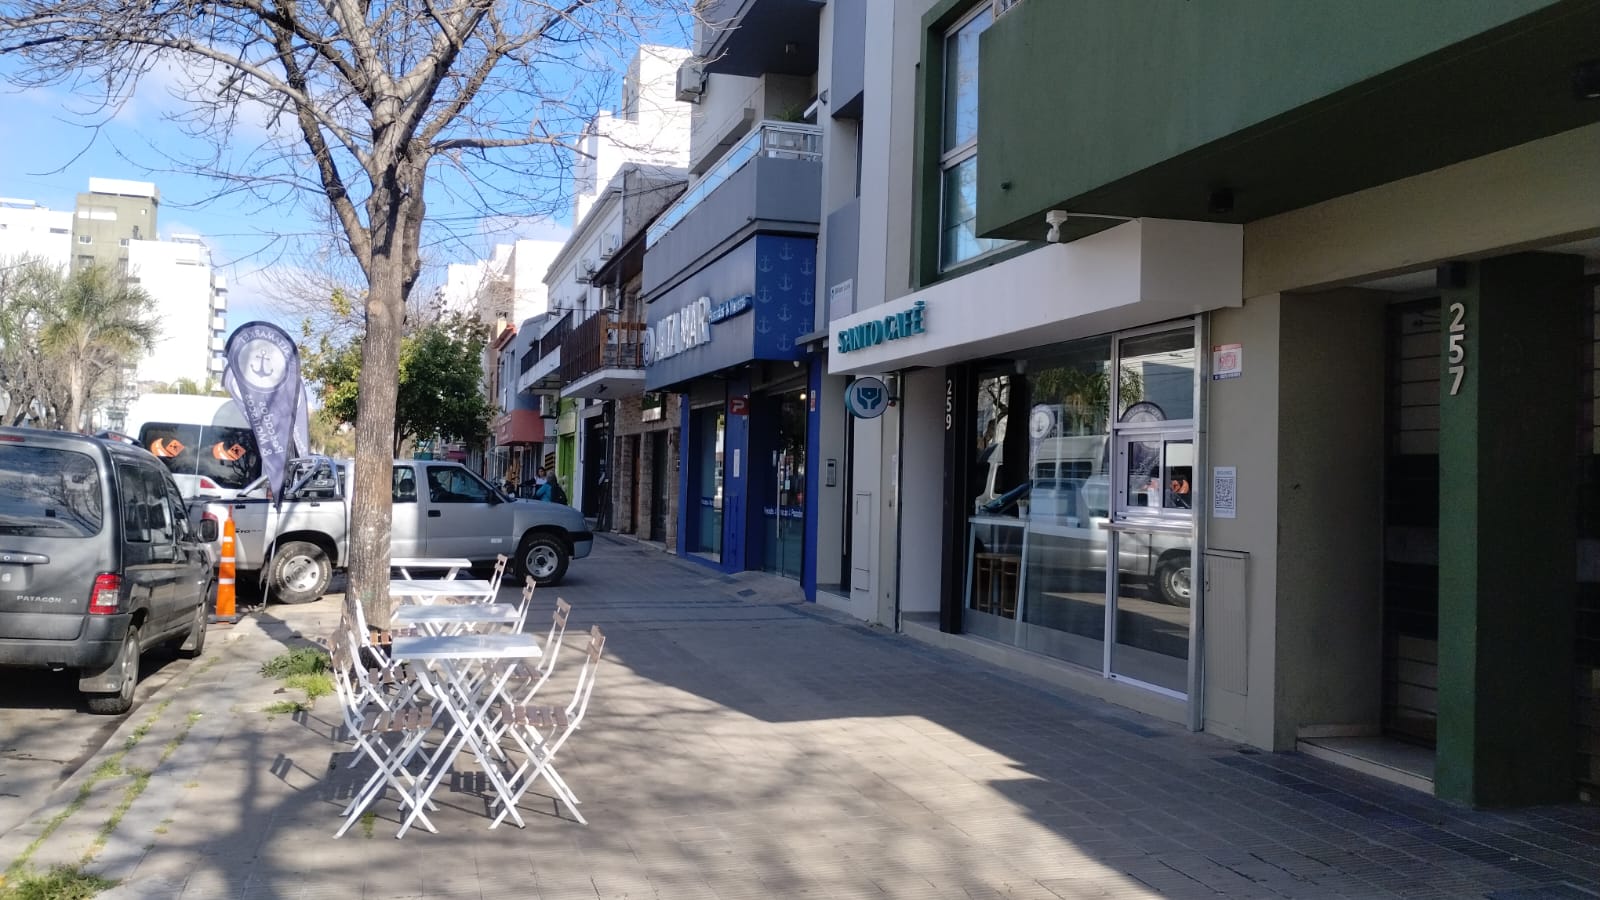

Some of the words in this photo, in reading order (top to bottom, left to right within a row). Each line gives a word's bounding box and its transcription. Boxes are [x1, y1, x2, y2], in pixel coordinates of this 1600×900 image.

[654, 310, 680, 362] ALTA
[680, 296, 711, 352] MAR
[838, 320, 882, 353] SANTO
[883, 300, 925, 340] CAFÉ
[1448, 302, 1465, 396] 257
